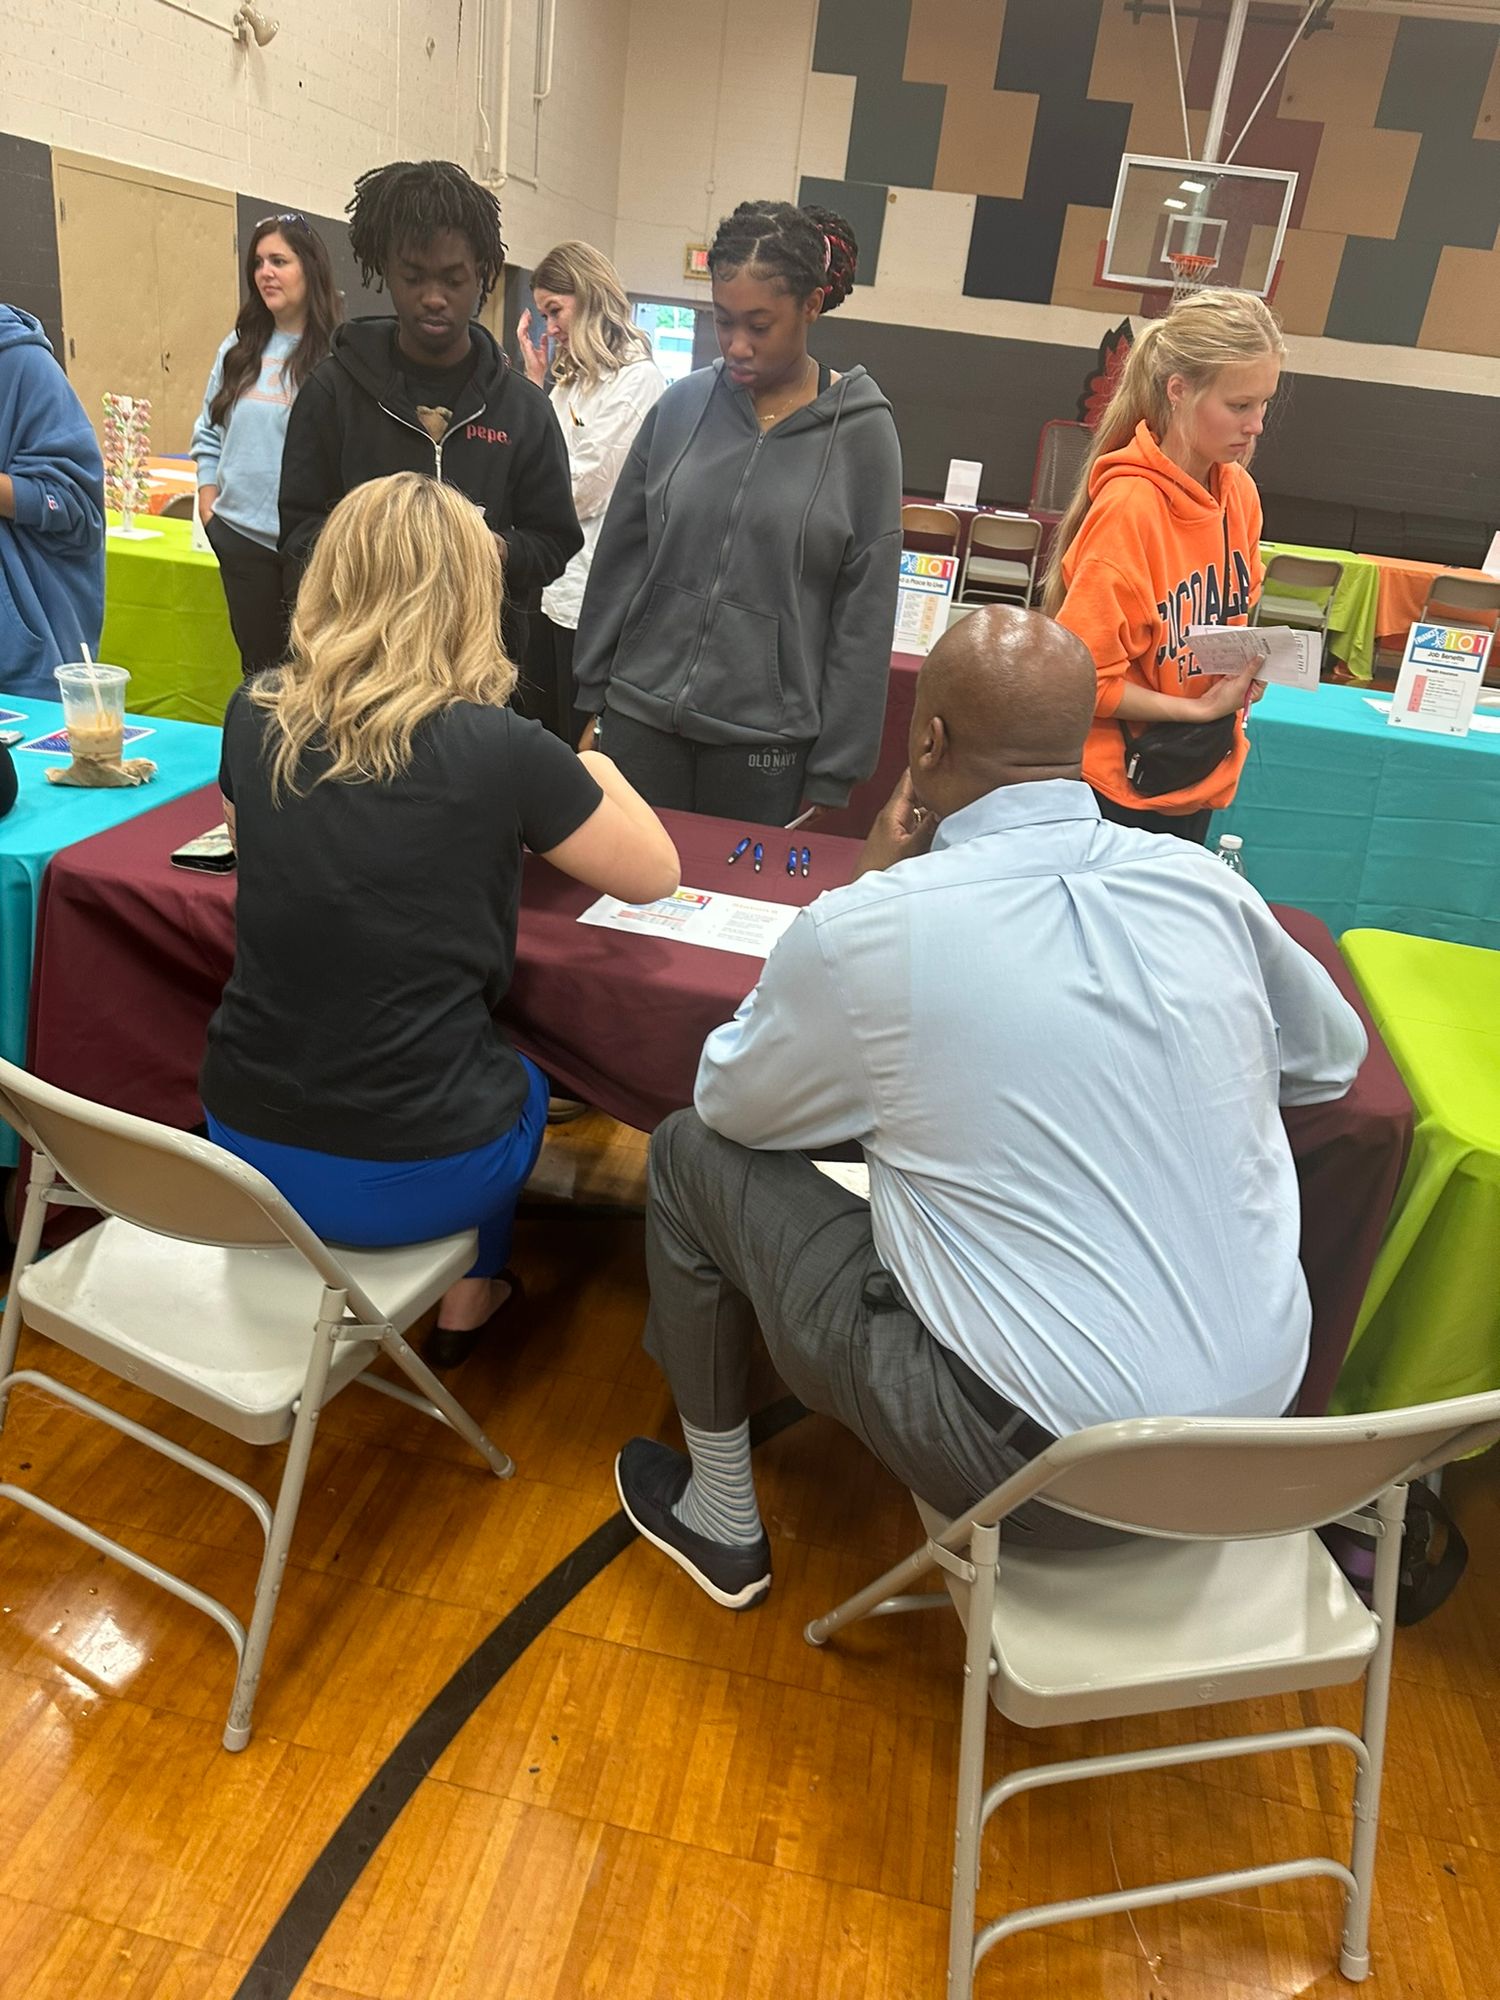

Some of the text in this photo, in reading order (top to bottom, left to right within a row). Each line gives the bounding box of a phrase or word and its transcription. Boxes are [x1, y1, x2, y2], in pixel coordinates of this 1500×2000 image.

[921, 558, 952, 577] 101
[1450, 633, 1485, 653] 101
[1441, 652, 1465, 662] Benefits
[748, 751, 798, 767] OLD NAVY
